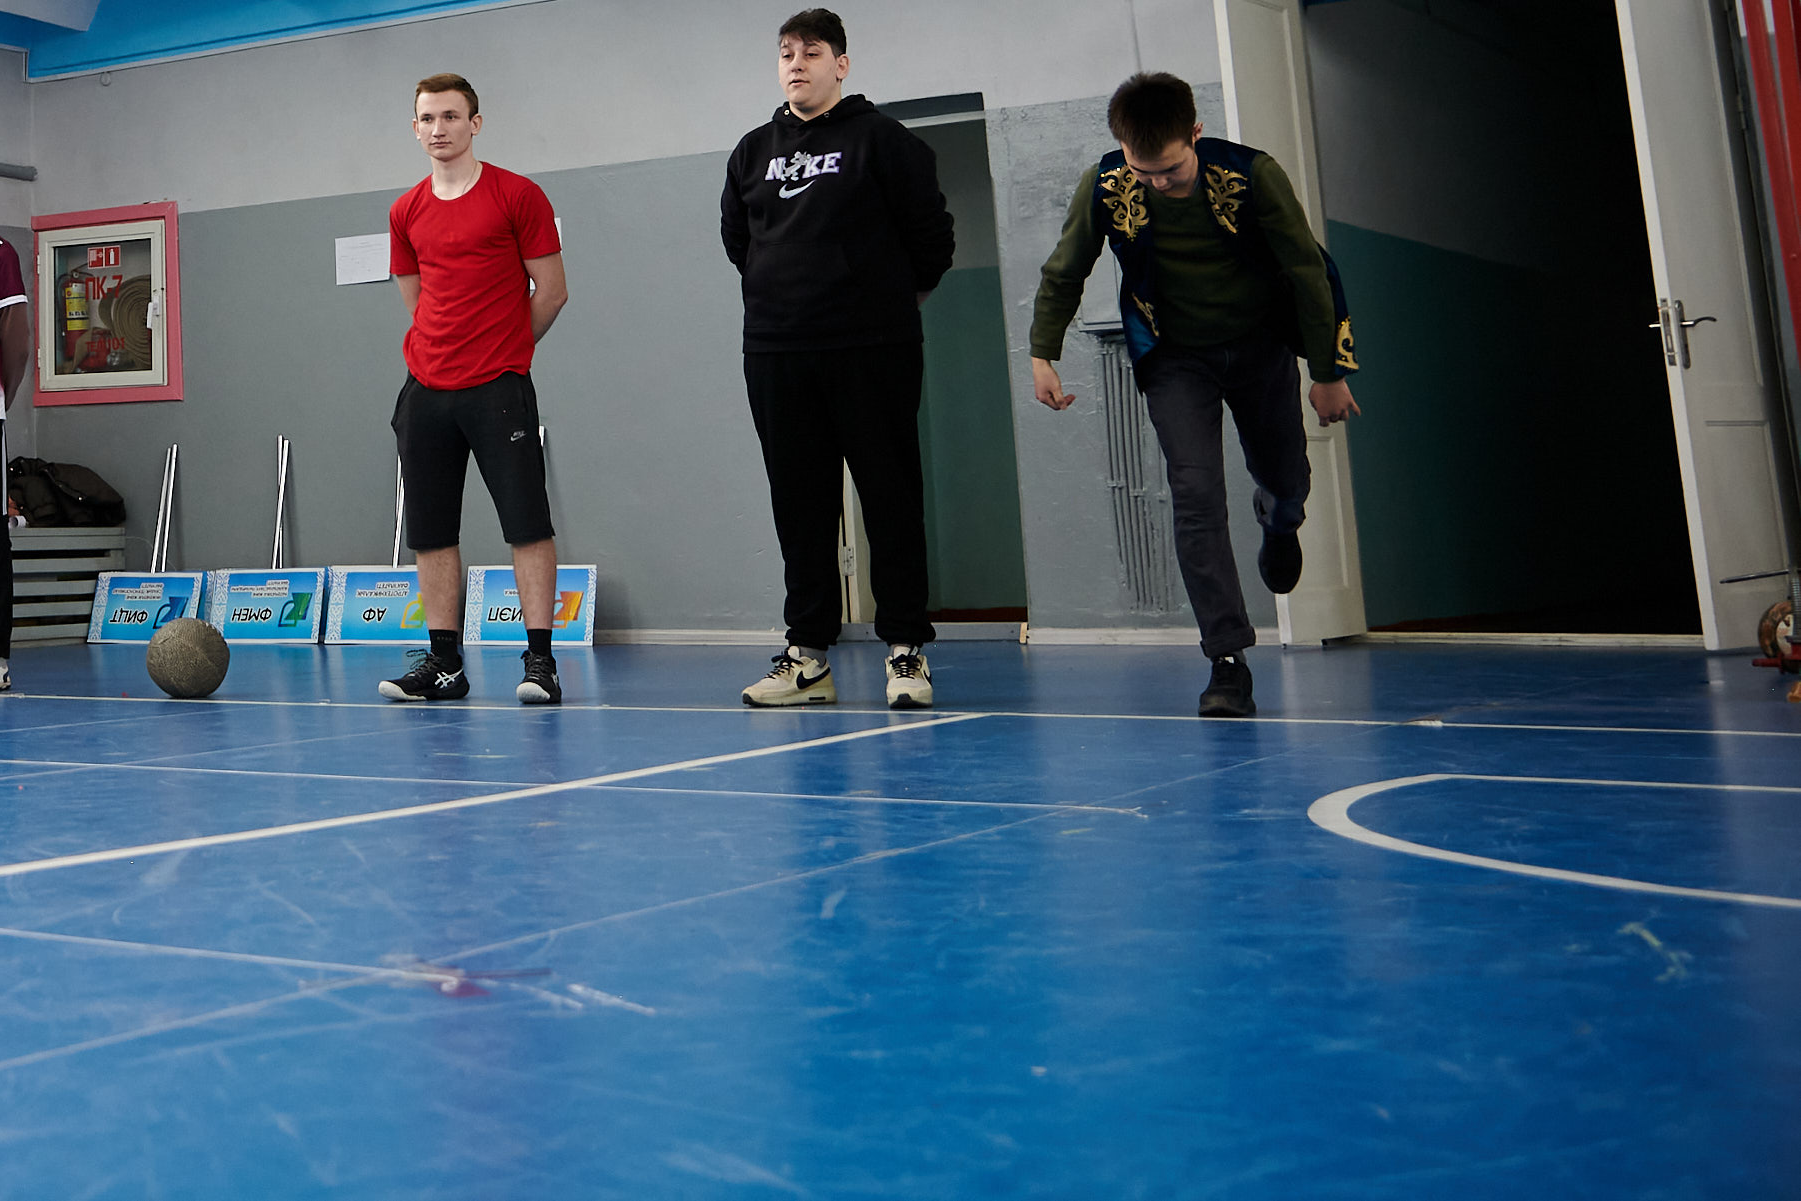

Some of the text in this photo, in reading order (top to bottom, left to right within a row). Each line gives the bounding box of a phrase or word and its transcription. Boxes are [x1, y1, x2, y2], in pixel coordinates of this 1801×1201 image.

[85, 274, 123, 300] ПК-7
[109, 607, 148, 623] ФИЦТ
[231, 607, 272, 622] ФМЕН
[362, 607, 387, 622] АФ
[487, 607, 523, 622] ИЭП
